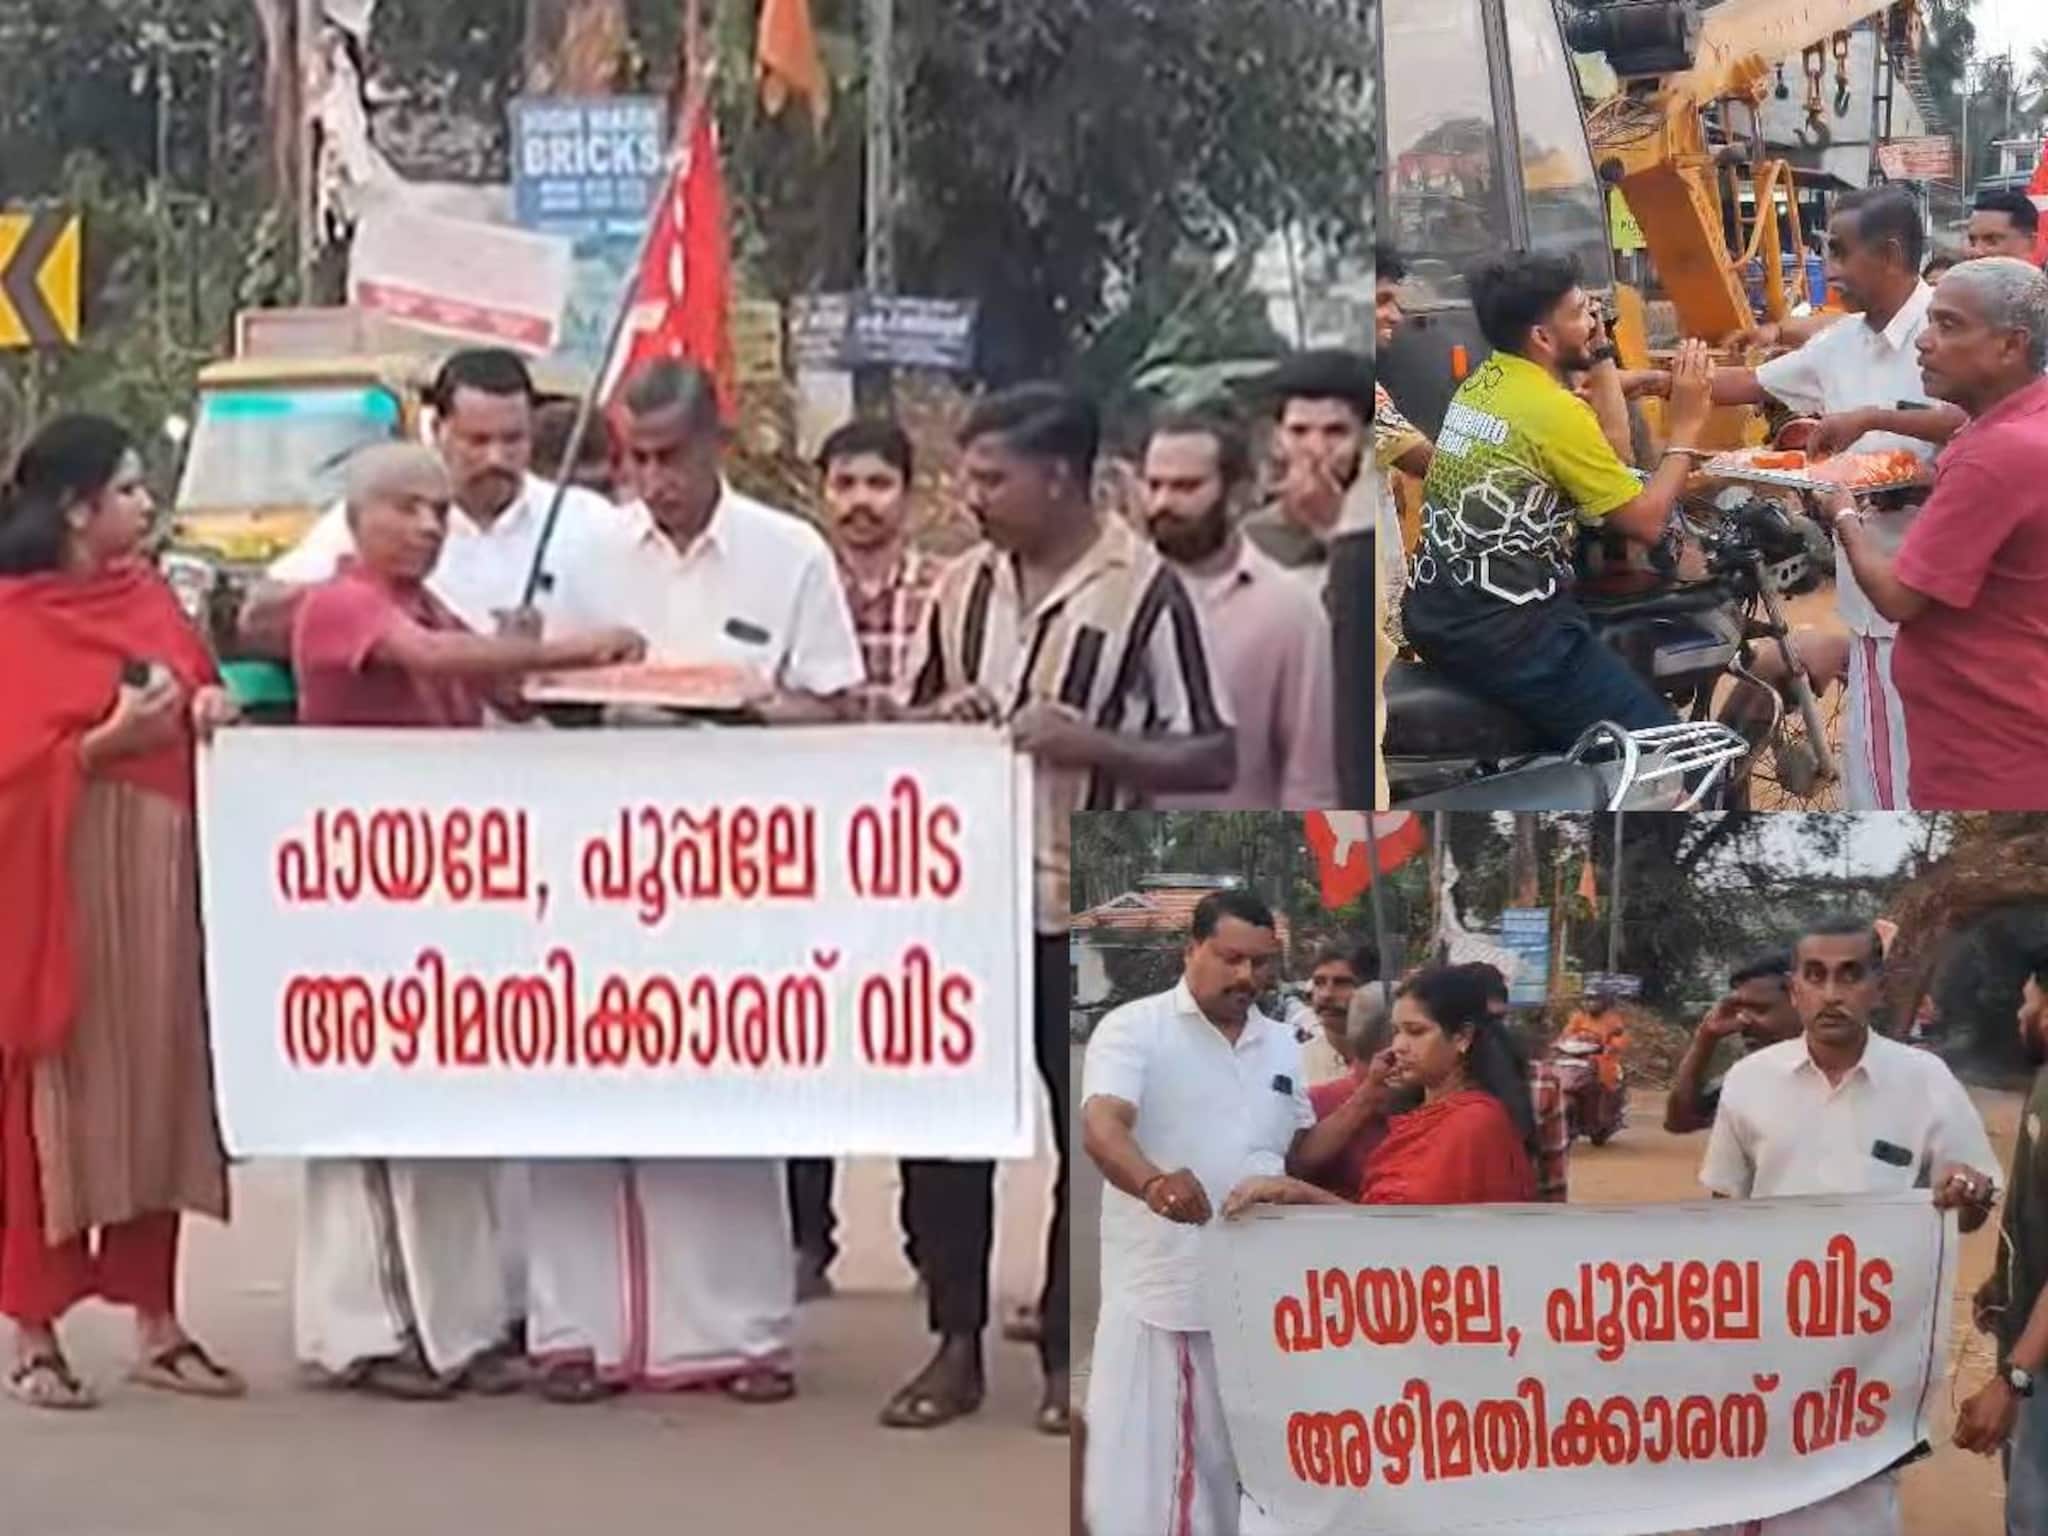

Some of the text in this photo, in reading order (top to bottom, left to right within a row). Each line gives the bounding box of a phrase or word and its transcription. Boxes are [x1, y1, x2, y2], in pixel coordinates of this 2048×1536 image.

[523, 134, 660, 176] BRICKS
[276, 774, 962, 926] പായലേ, പൂപ്പലേ വിട
[281, 944, 975, 1070] അഴിമതിക്കാരന് വിട
[1273, 1232, 1895, 1364] പായലേ, പൂപ്പലേ വിട
[1286, 1366, 1895, 1491] അഴിമതിക്കാരന് വിട
